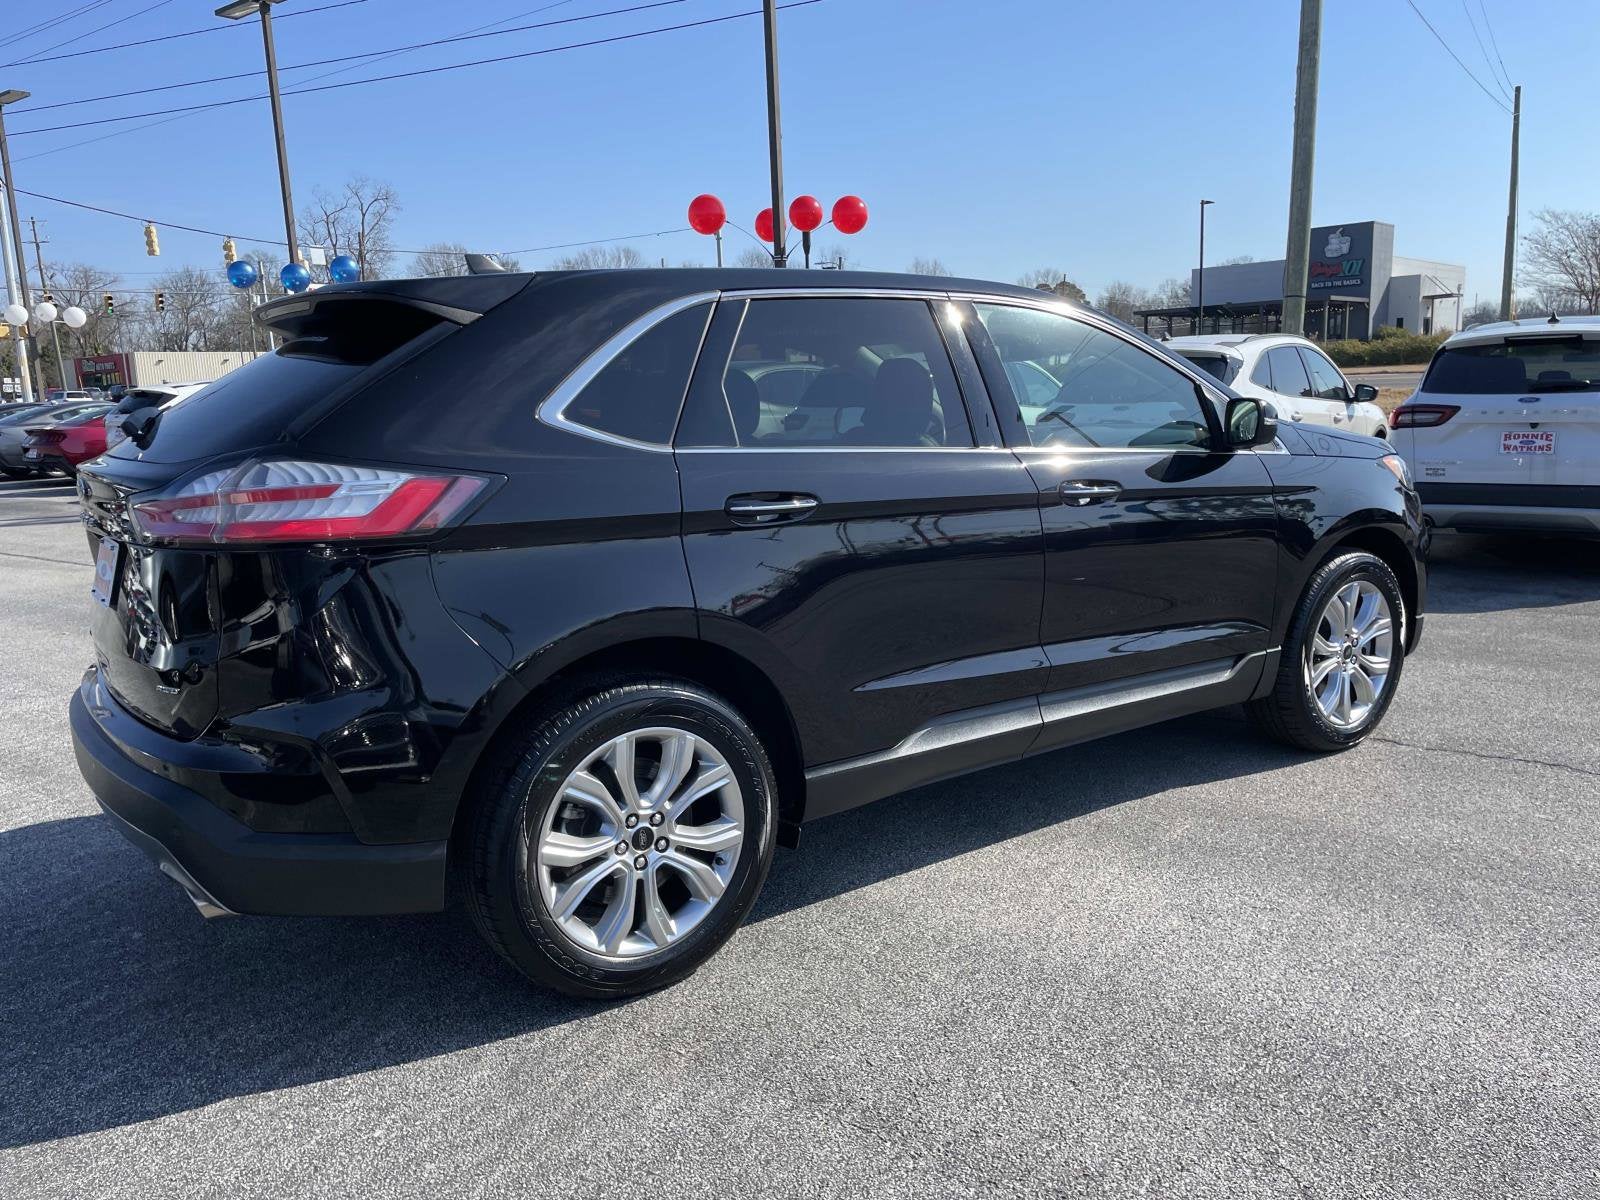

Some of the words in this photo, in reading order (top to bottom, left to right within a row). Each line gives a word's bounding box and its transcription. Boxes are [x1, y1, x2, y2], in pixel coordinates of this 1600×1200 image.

[1338, 260, 1363, 276] 101
[1503, 432, 1553, 442] RONNIE
[1503, 443, 1552, 451] WATKINS
